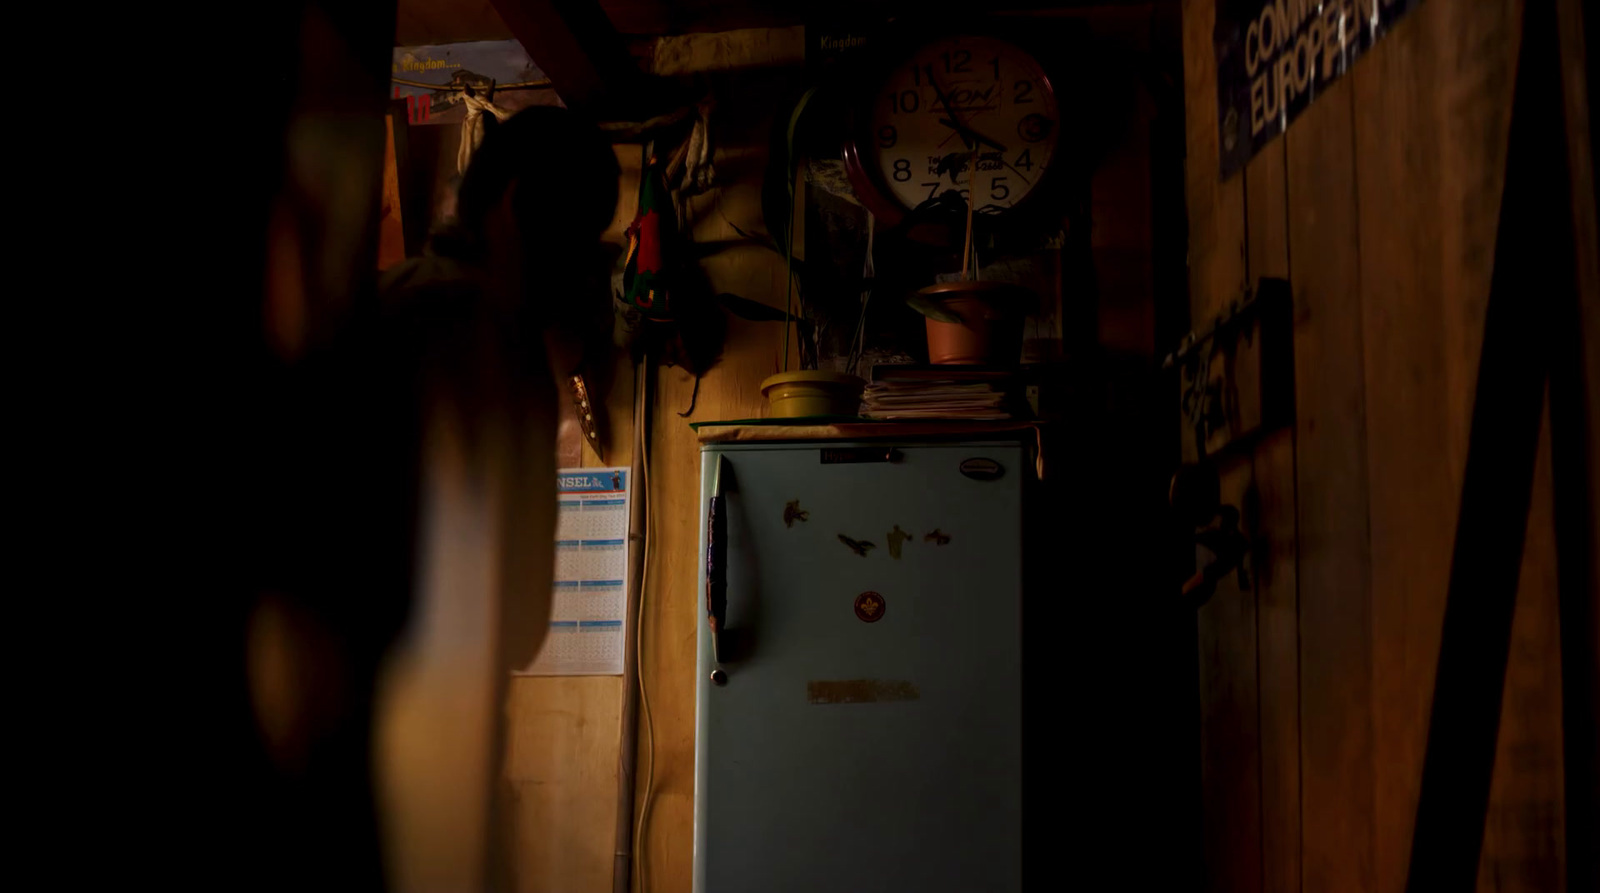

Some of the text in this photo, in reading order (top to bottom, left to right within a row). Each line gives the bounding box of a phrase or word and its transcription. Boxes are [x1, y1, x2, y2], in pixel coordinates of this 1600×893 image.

[1245, 0, 1323, 77] COMM
[942, 50, 972, 73] 12
[988, 57, 1000, 80] 1
[1251, 0, 1393, 137] EUROPEEN
[889, 90, 919, 114] 10
[1013, 80, 1034, 104] 2
[877, 125, 898, 148] 9
[893, 159, 912, 182] 8
[1013, 149, 1034, 172] 4
[921, 182, 940, 200] 7
[990, 177, 1010, 200] 5
